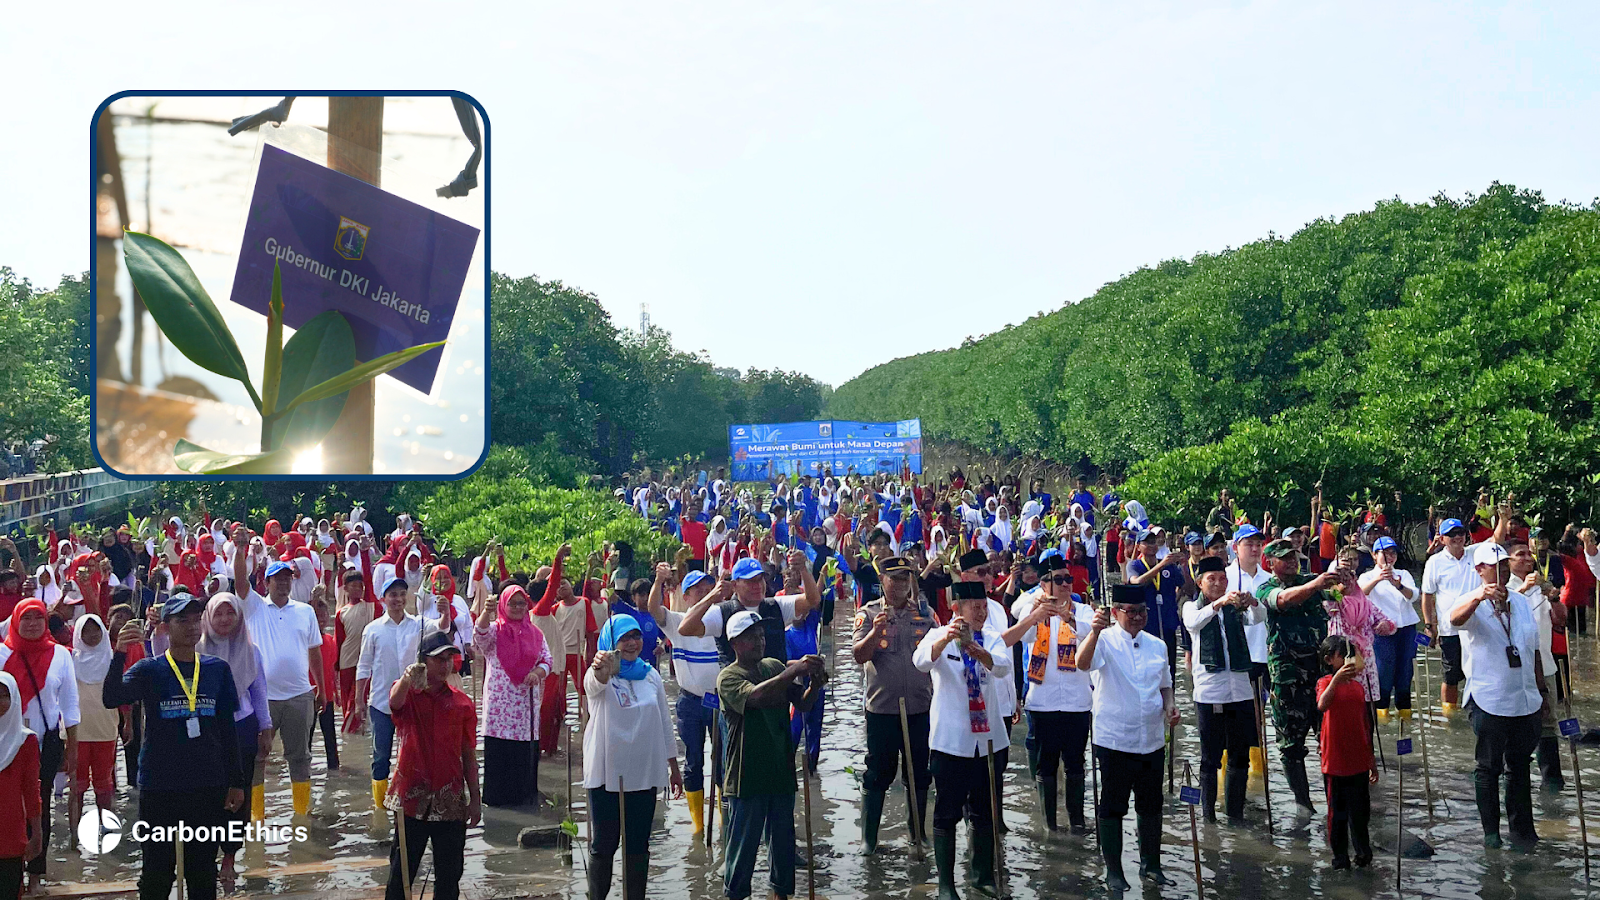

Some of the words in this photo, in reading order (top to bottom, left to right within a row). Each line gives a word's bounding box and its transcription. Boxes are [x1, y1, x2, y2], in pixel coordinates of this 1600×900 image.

[264, 237, 337, 281] Gubernur
[339, 270, 370, 296] DKI
[371, 285, 431, 324] Jakarta
[748, 444, 789, 453] Merawat
[791, 442, 816, 451] Bumi
[818, 441, 845, 449] untuk
[847, 440, 871, 448] Masa
[873, 440, 904, 449] Depan
